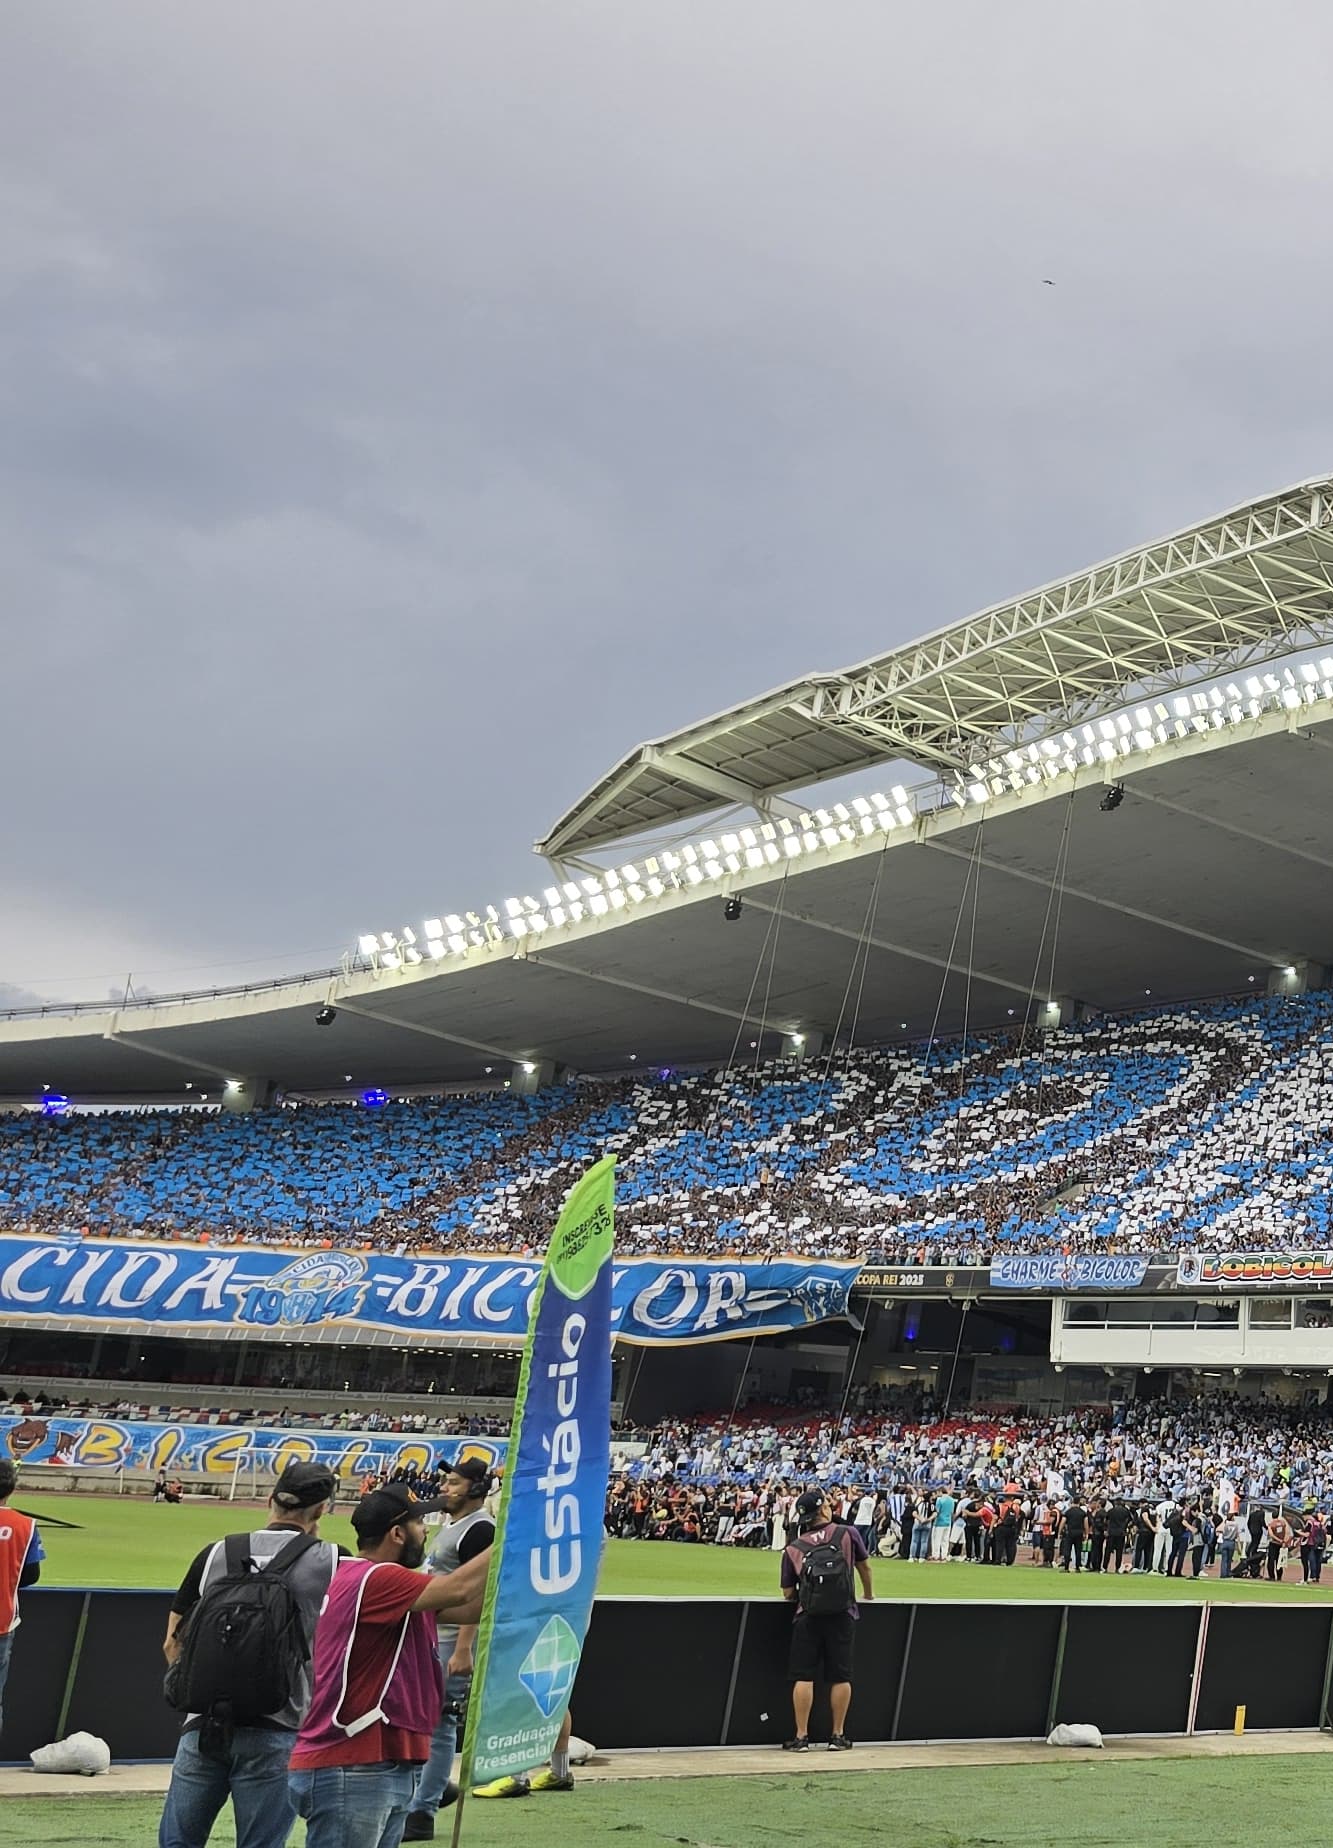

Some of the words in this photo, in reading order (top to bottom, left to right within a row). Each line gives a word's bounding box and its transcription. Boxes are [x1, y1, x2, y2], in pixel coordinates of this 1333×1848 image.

[882, 1274, 898, 1286] REI
[1001, 1259, 1058, 1281] CHARME
[1081, 1258, 1142, 1281] BICOLOR
[531, 1313, 586, 1595] Estácio
[487, 1722, 560, 1750] Graduação
[475, 1742, 552, 1771] Presencial
